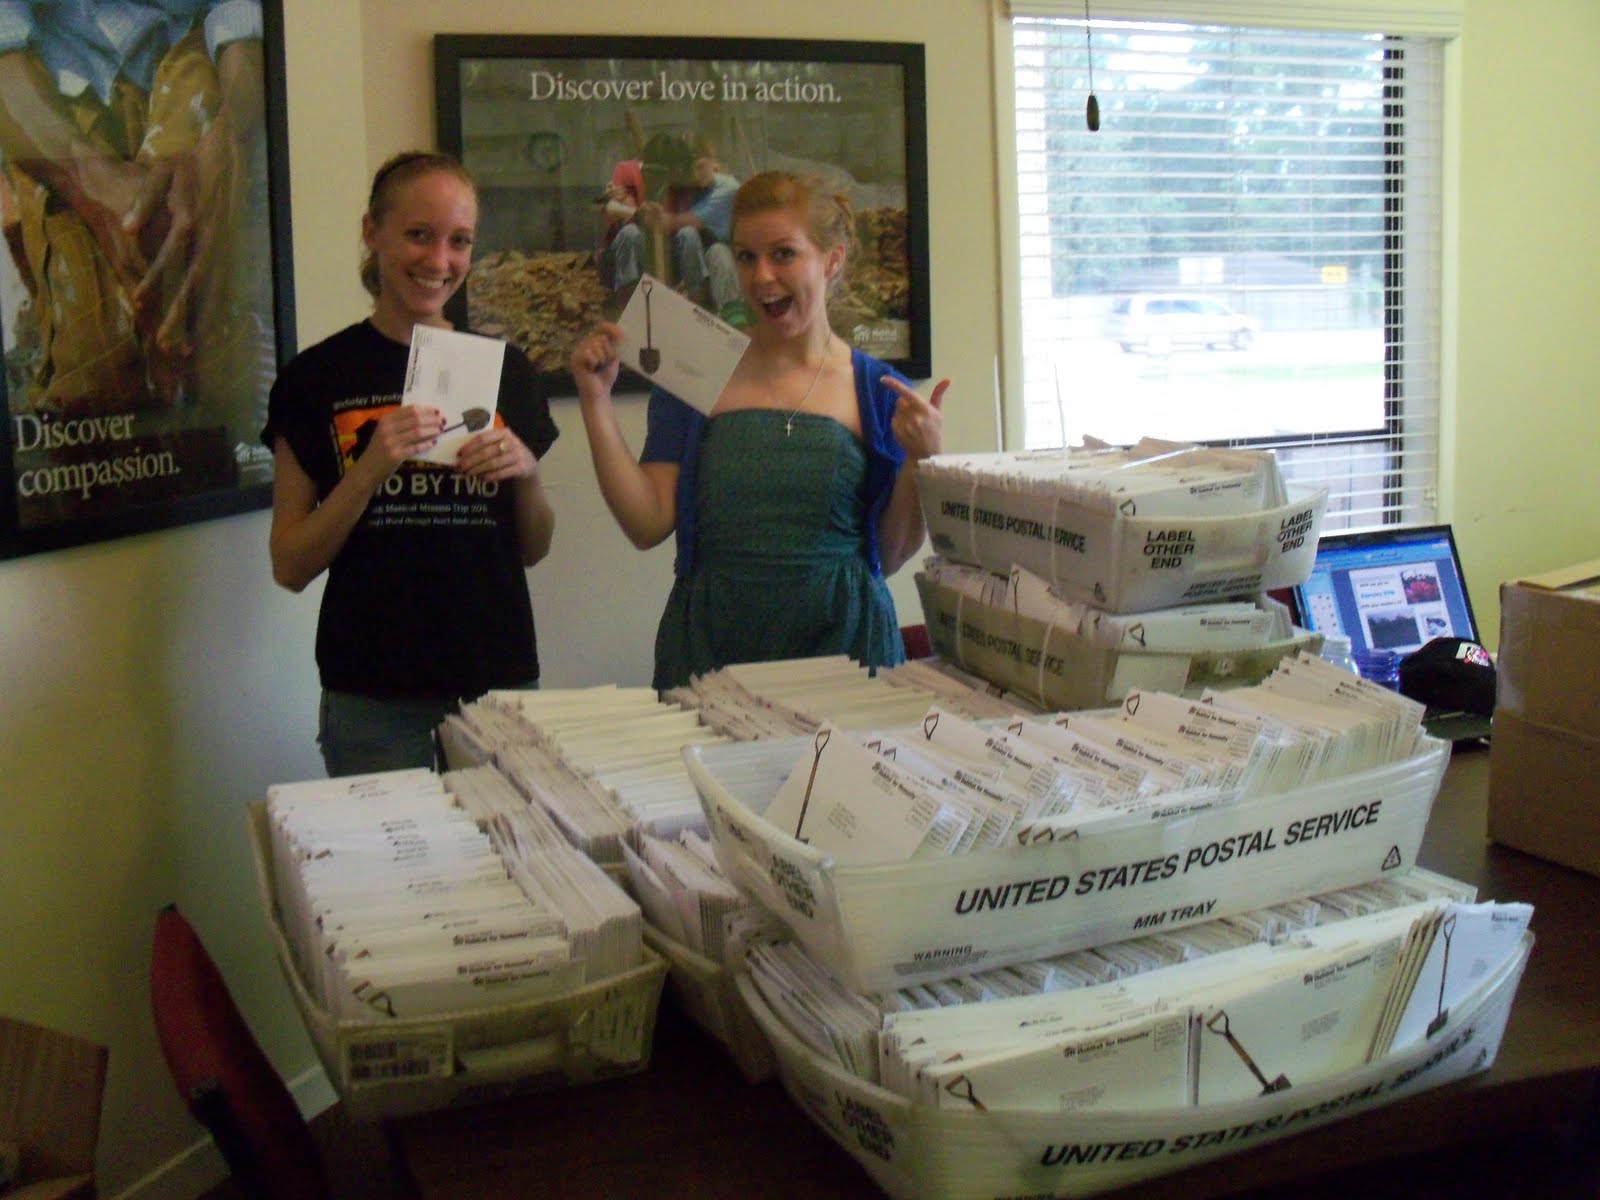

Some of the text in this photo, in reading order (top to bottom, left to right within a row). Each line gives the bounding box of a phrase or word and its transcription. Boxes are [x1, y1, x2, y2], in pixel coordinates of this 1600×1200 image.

[530, 71, 842, 103] Discover love in action.
[14, 412, 136, 451] Discover
[18, 446, 182, 499] compassion.
[410, 473, 444, 496] BY
[450, 474, 500, 499] TWO
[973, 506, 1005, 531] STATES
[1006, 515, 1046, 541] POSTAL
[1277, 519, 1314, 544] OTHER
[1280, 508, 1314, 531] LABEL
[1143, 543, 1195, 557] OTHER
[1146, 529, 1196, 543] LABEL
[1281, 535, 1306, 554] END
[1151, 557, 1182, 570] END
[1025, 646, 1065, 677] SERICE
[954, 800, 1384, 916] UNITED STATES POSTAL SERVICE
[1132, 899, 1219, 931] MM TRAY
[913, 943, 973, 961] WARNING
[1039, 1138, 1166, 1167] UNITED
[1169, 1113, 1284, 1152] STATES
